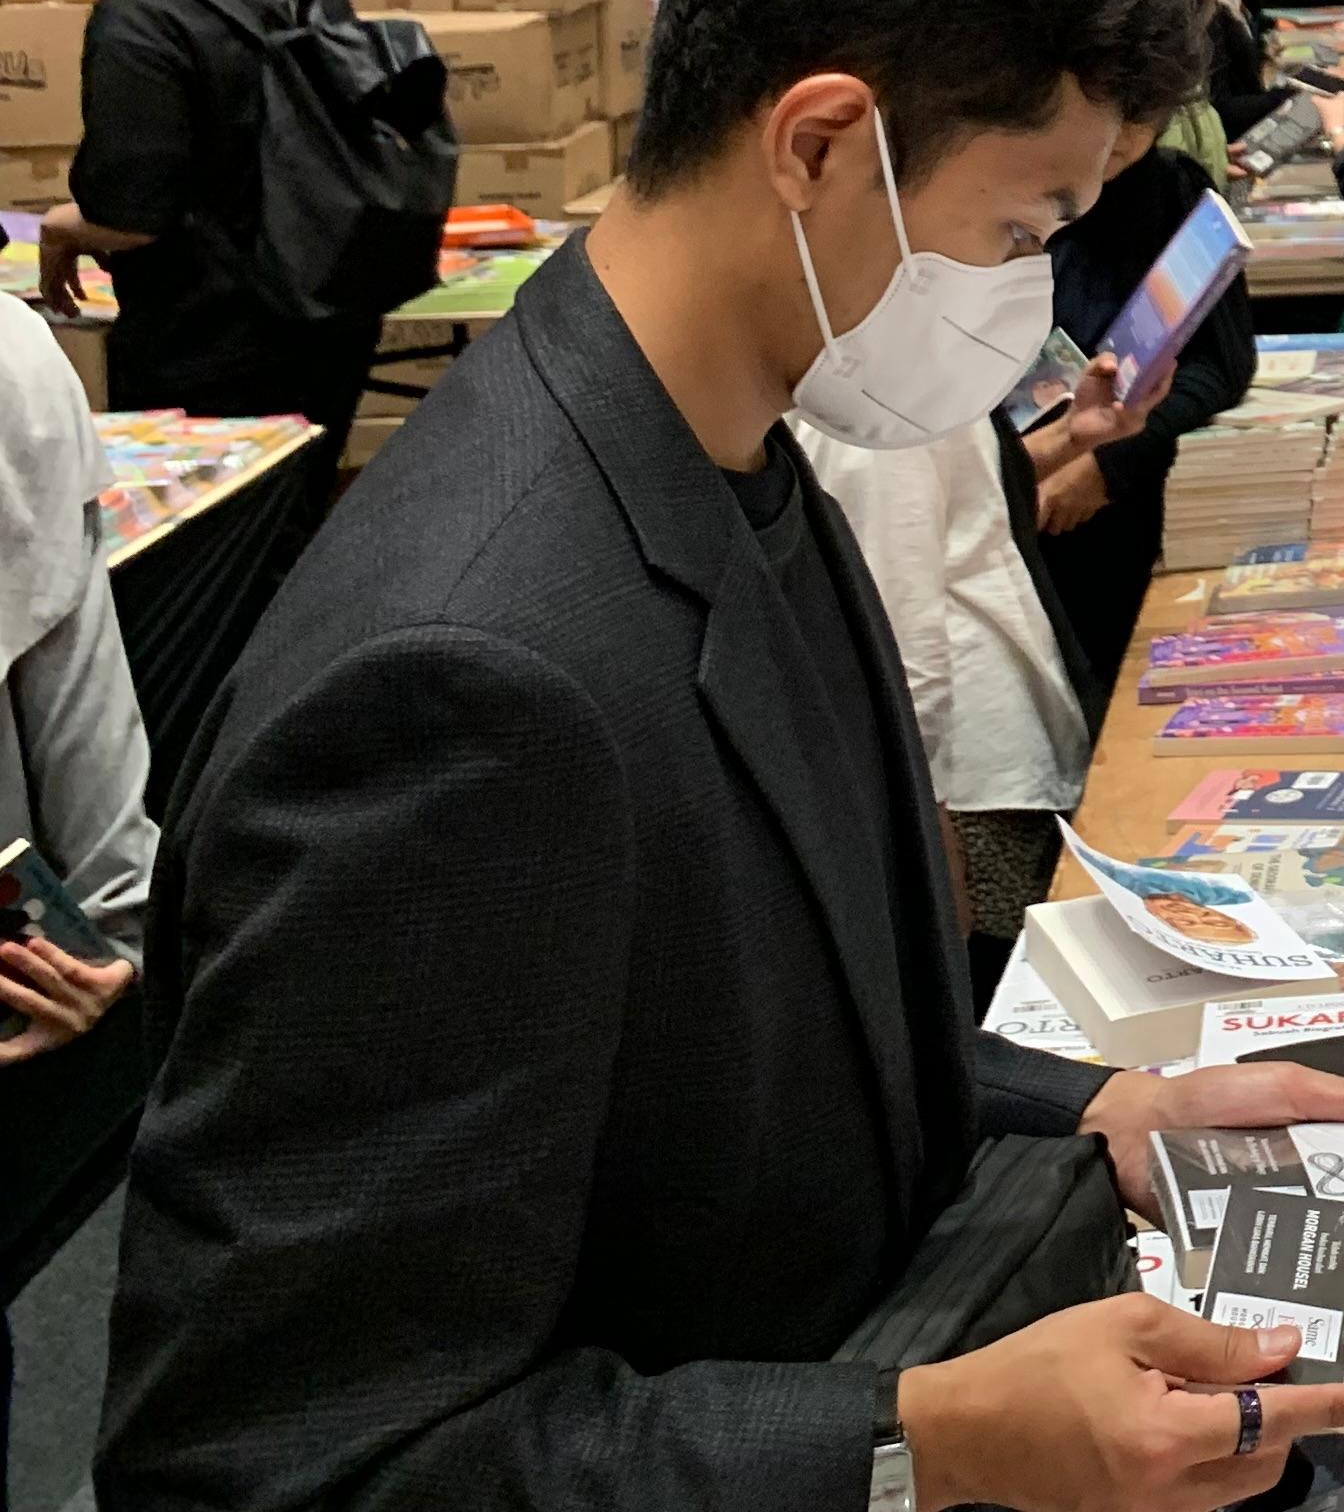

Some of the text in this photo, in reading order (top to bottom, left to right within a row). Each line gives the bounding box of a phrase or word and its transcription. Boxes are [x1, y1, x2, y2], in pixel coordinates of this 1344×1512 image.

[1292, 1209, 1321, 1291] MORGAN HOUSEL
[1304, 1316, 1327, 1349] Same
